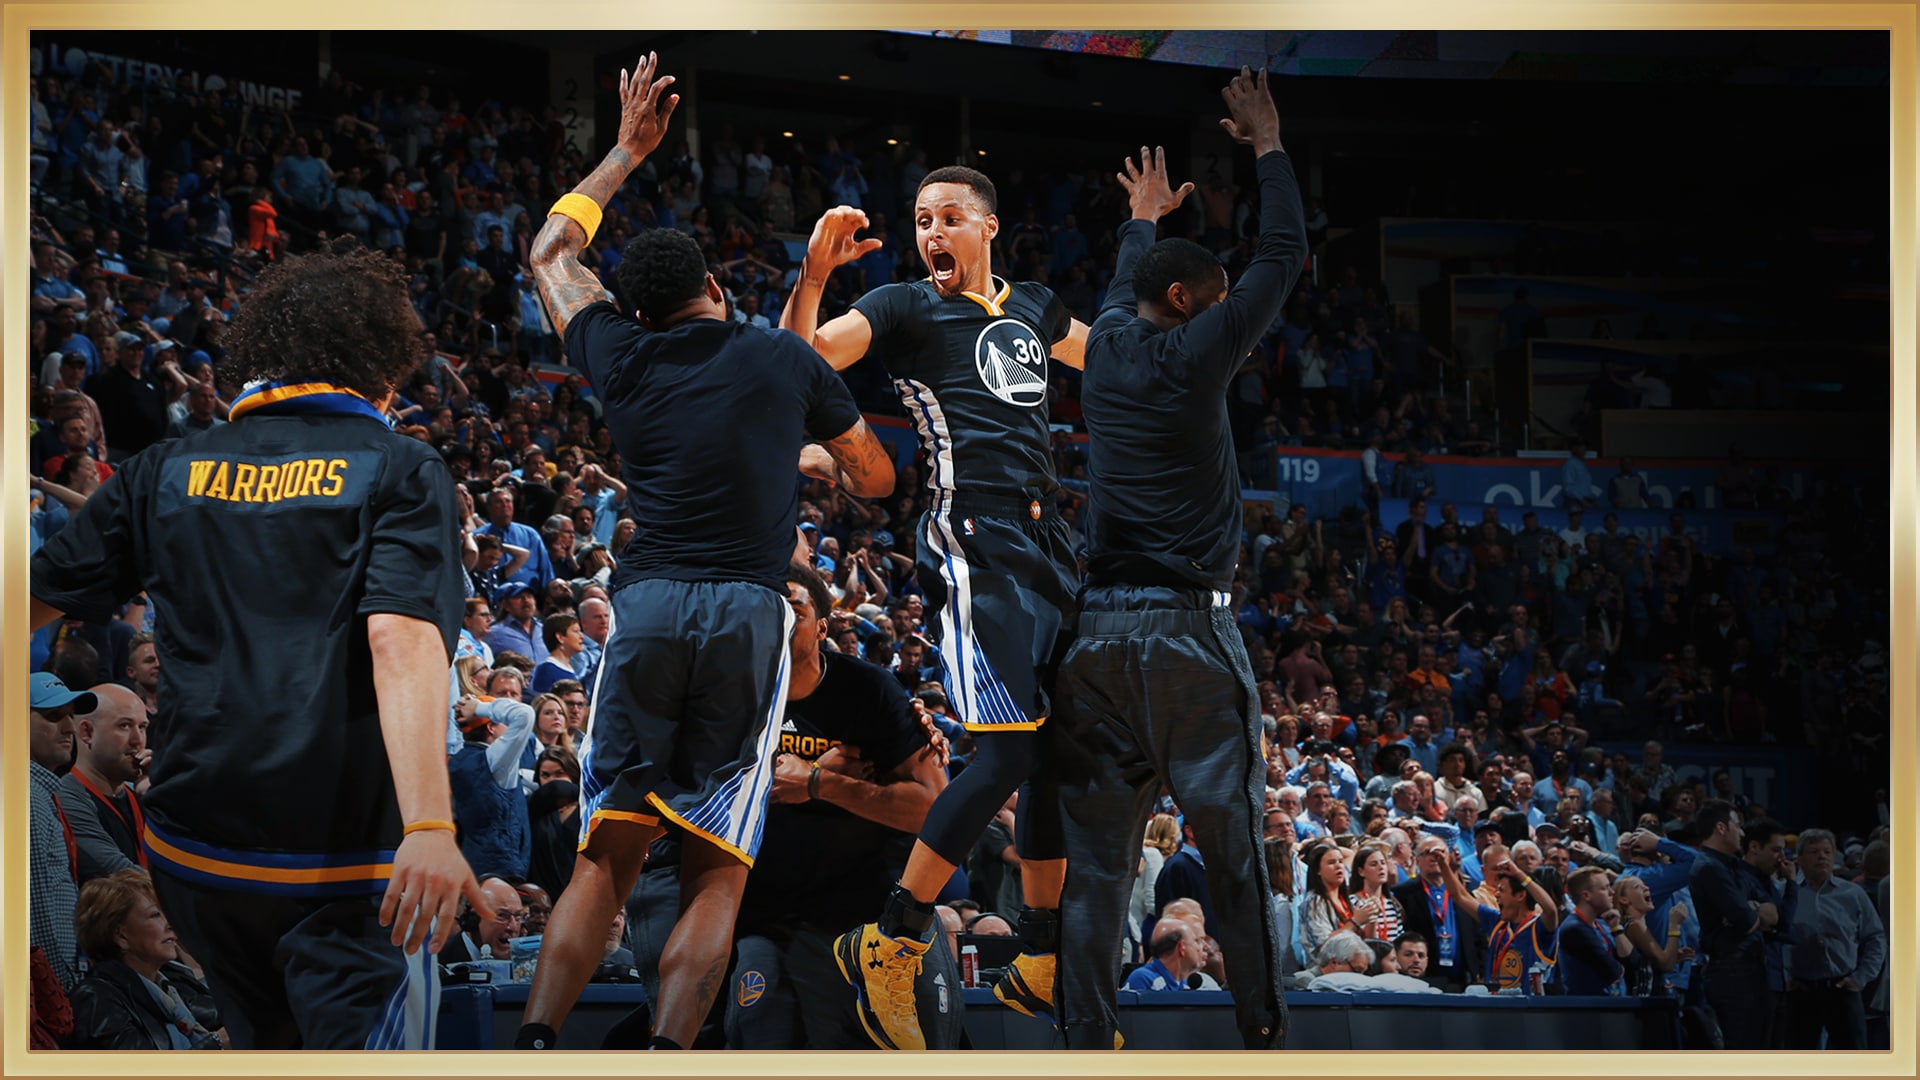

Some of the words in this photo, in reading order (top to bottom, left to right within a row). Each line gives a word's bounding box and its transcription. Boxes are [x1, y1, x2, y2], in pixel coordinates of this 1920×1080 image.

[1012, 338, 1042, 366] 30
[187, 459, 348, 502] WARRIORS
[1279, 458, 1320, 482] 119
[778, 734, 843, 756] RIOR
[1505, 958, 1517, 968] 30
